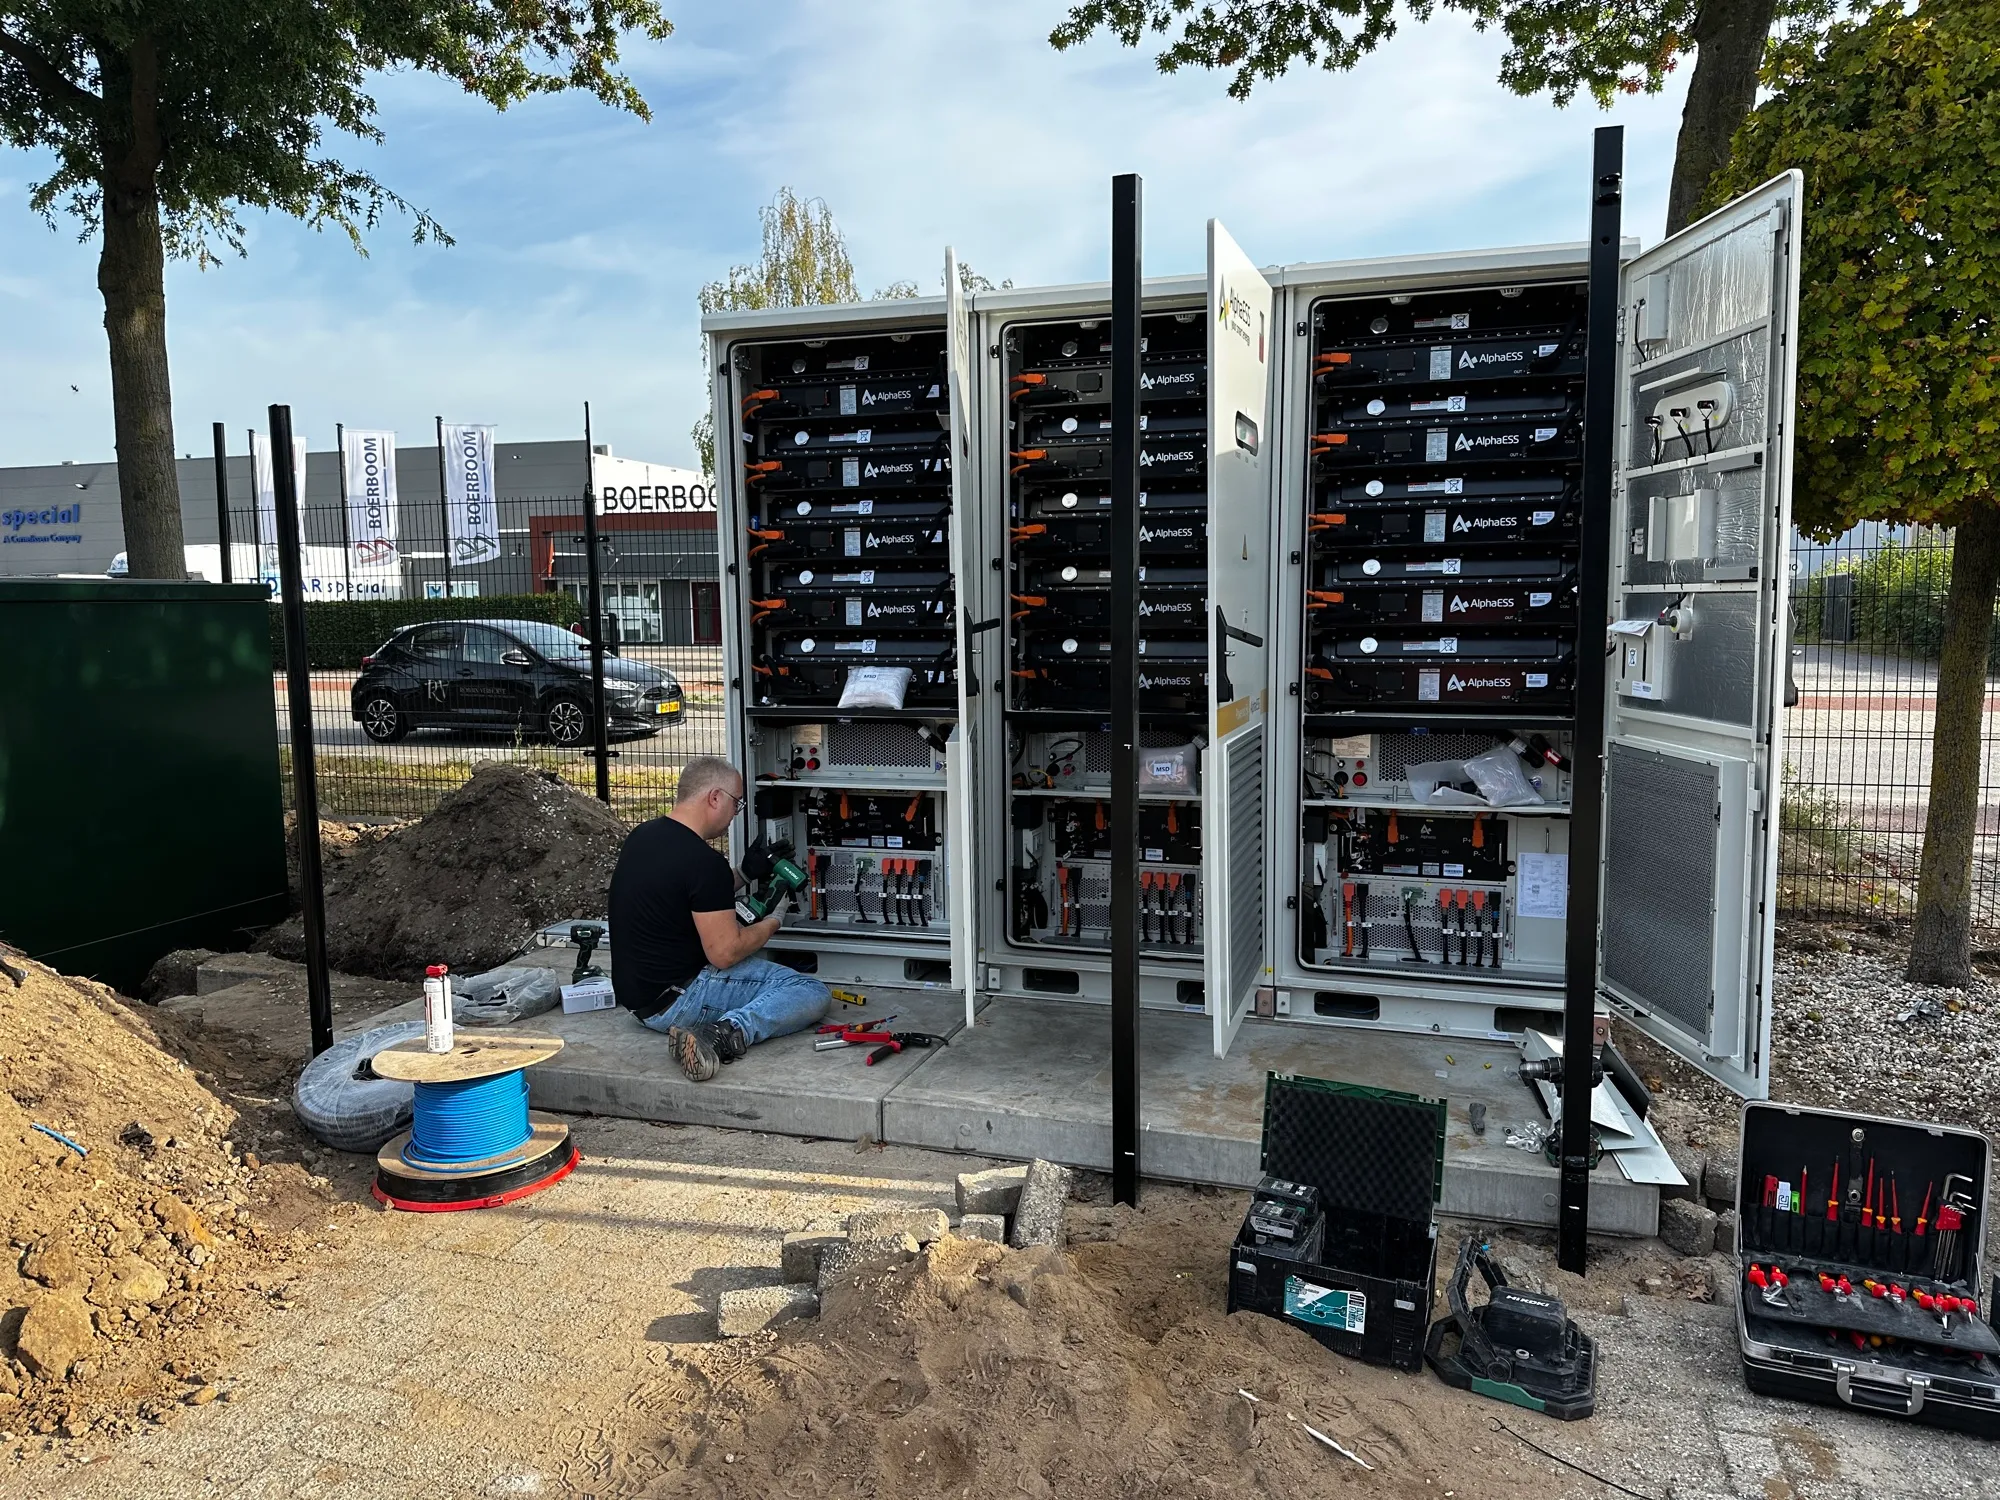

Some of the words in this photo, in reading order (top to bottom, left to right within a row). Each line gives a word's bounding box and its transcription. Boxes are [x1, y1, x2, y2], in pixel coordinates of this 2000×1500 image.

[1479, 352, 1523, 364] AlphaESS
[1156, 374, 1194, 385] AlphaESS
[877, 391, 911, 401] AlphaESS
[1475, 435, 1519, 446] AlphaESS
[1155, 452, 1193, 462] AlphaESS
[880, 464, 913, 474] AlphaESS
[363, 437, 382, 529] BOERBOOM
[463, 431, 482, 525] BOERBOOM
[2, 503, 80, 531] special
[1472, 517, 1516, 528] AlphaESS
[1154, 528, 1192, 538] AlphaESS
[880, 535, 914, 544] AlphaESS
[328, 579, 386, 597] special
[1154, 604, 1191, 613] AlphaESS
[1470, 599, 1514, 609] AlphaESS
[882, 605, 915, 614] AlphaESS
[1153, 677, 1190, 686] AlphaESS
[1467, 678, 1511, 688] AlphaESS
